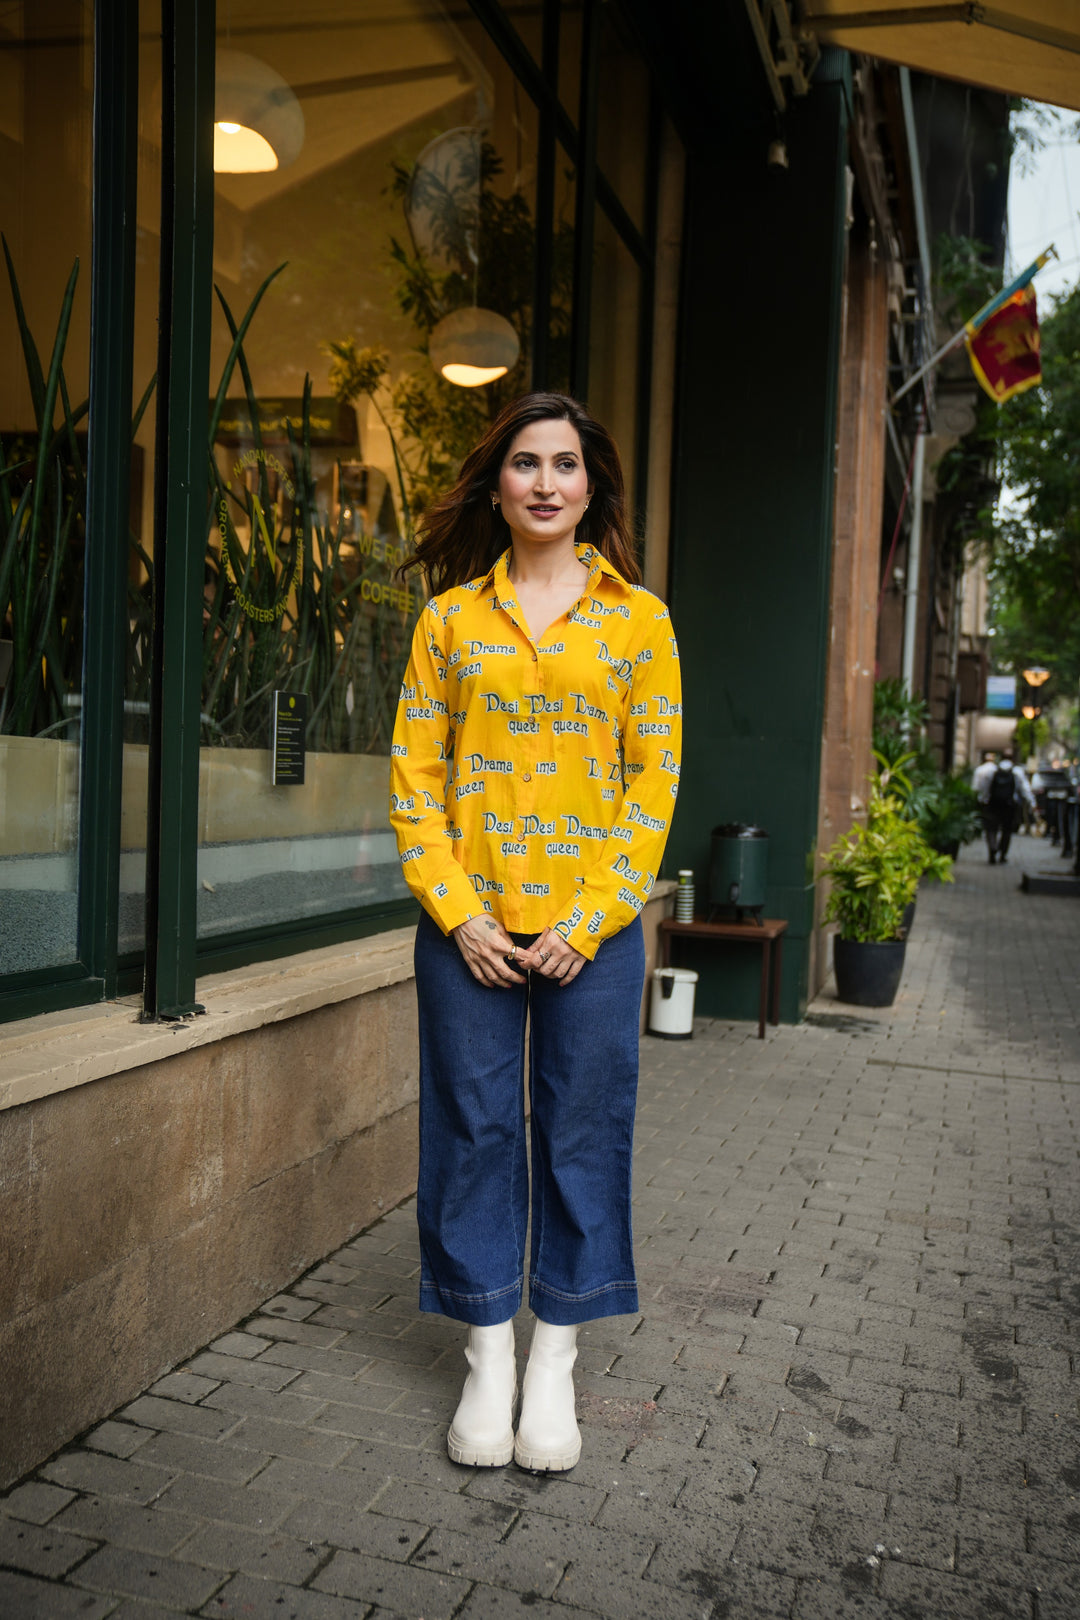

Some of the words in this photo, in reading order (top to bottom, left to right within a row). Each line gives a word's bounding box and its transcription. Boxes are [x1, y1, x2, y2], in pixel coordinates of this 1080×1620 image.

[233, 449, 267, 479] NANDAN
[234, 586, 275, 622] ROASTERS
[361, 579, 415, 614] COFFEE
[589, 596, 631, 619] Drama
[464, 640, 517, 657] Drama
[480, 692, 519, 713] Desi
[629, 702, 647, 716] esi
[553, 720, 588, 737] queen
[637, 723, 671, 737] queen
[464, 753, 513, 774] Drama
[659, 749, 680, 776] Des
[482, 812, 513, 833] Desi
[519, 814, 556, 835] Desi
[561, 815, 608, 840] Drama
[626, 801, 666, 830] Drama
[502, 842, 527, 857] quee
[546, 843, 580, 858] queen
[612, 853, 642, 883] Desi
[553, 904, 584, 940] Desi
[587, 910, 605, 934] que
